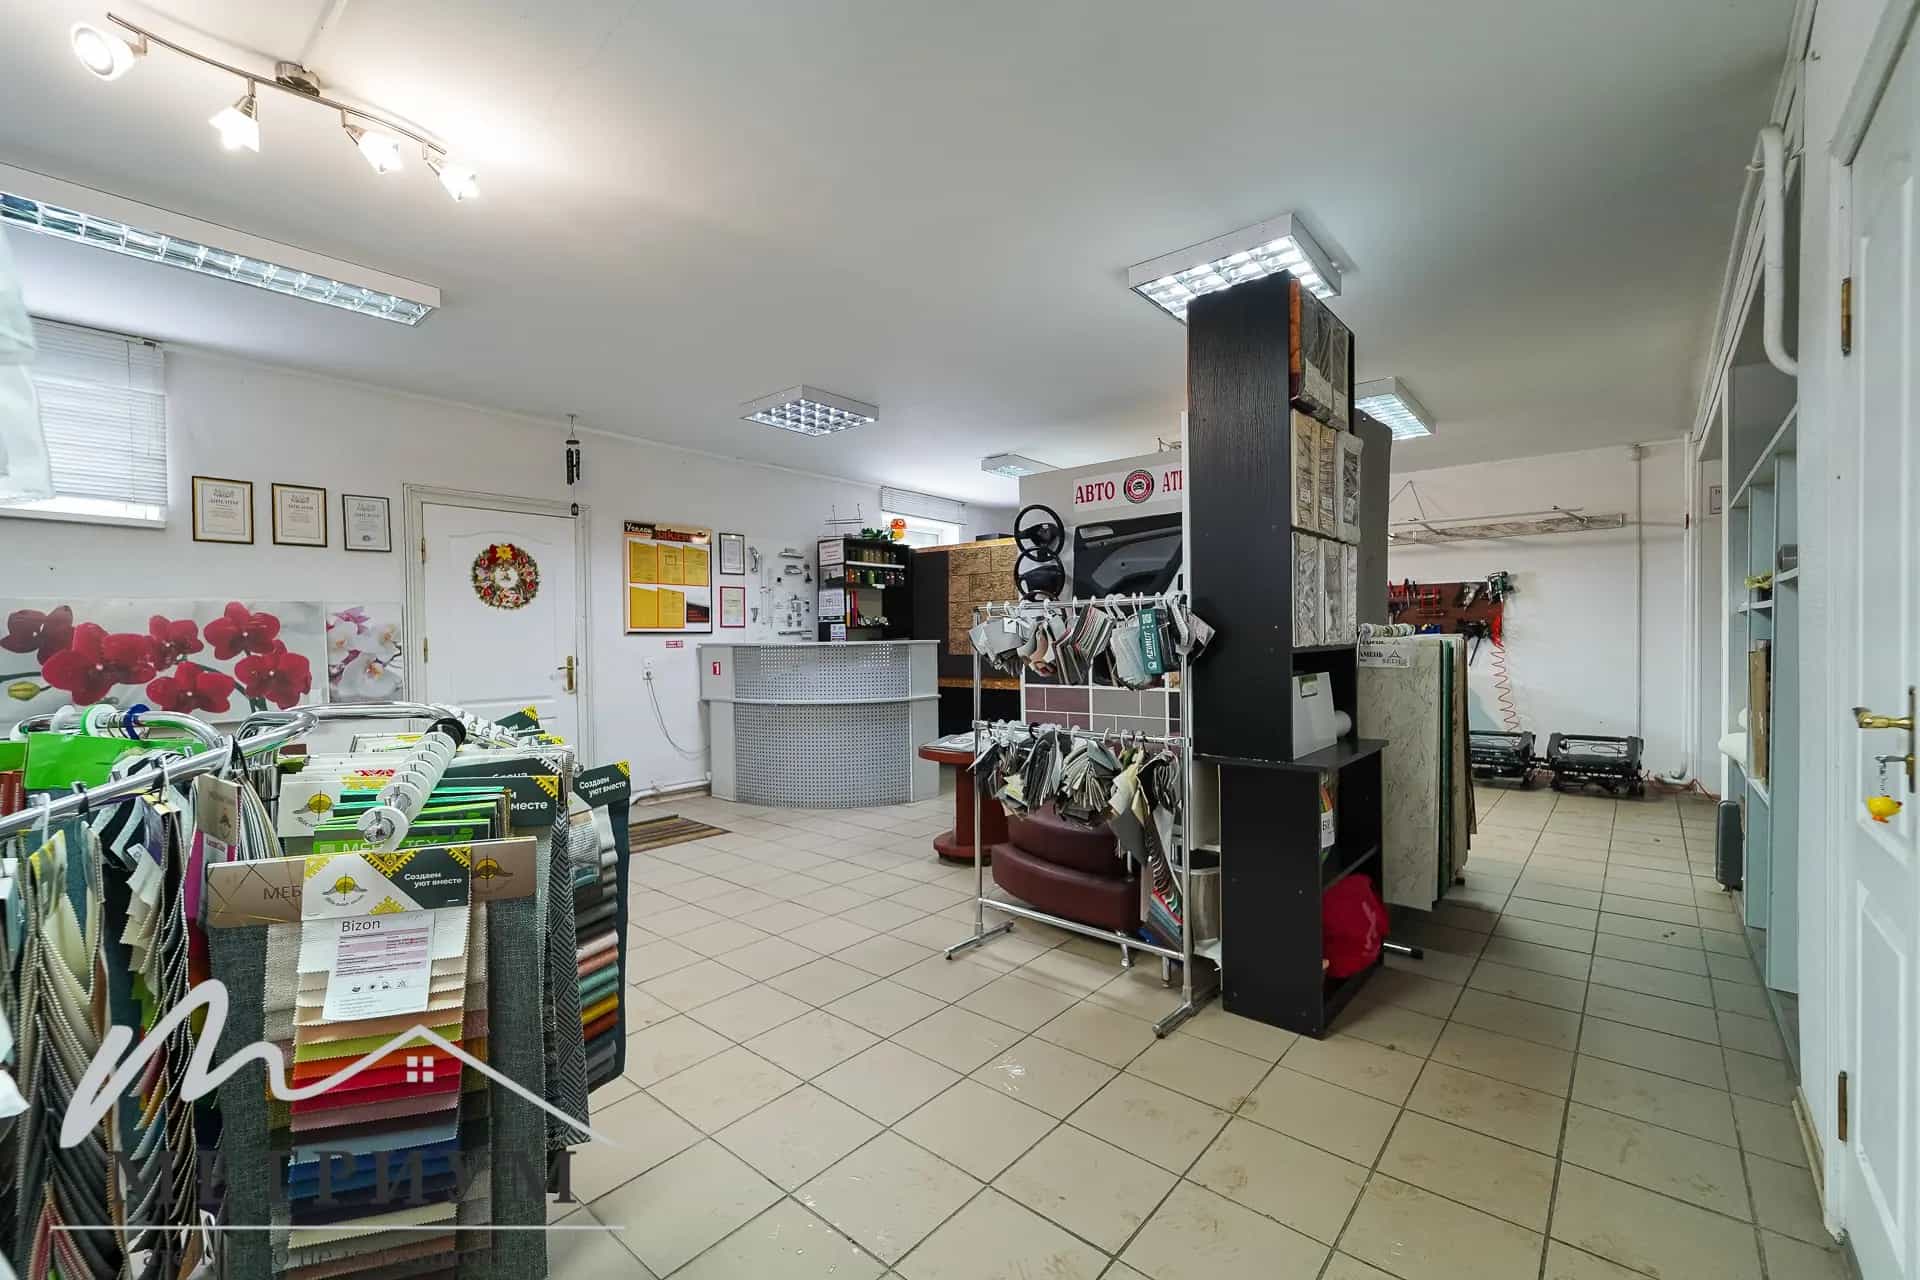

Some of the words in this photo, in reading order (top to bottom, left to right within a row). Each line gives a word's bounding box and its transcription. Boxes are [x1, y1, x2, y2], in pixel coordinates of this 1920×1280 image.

[1075, 481, 1115, 504] АВТО
[511, 801, 548, 811] месте
[404, 871, 442, 881] Создаем
[413, 879, 431, 889] уют
[341, 919, 381, 933] Bizon
